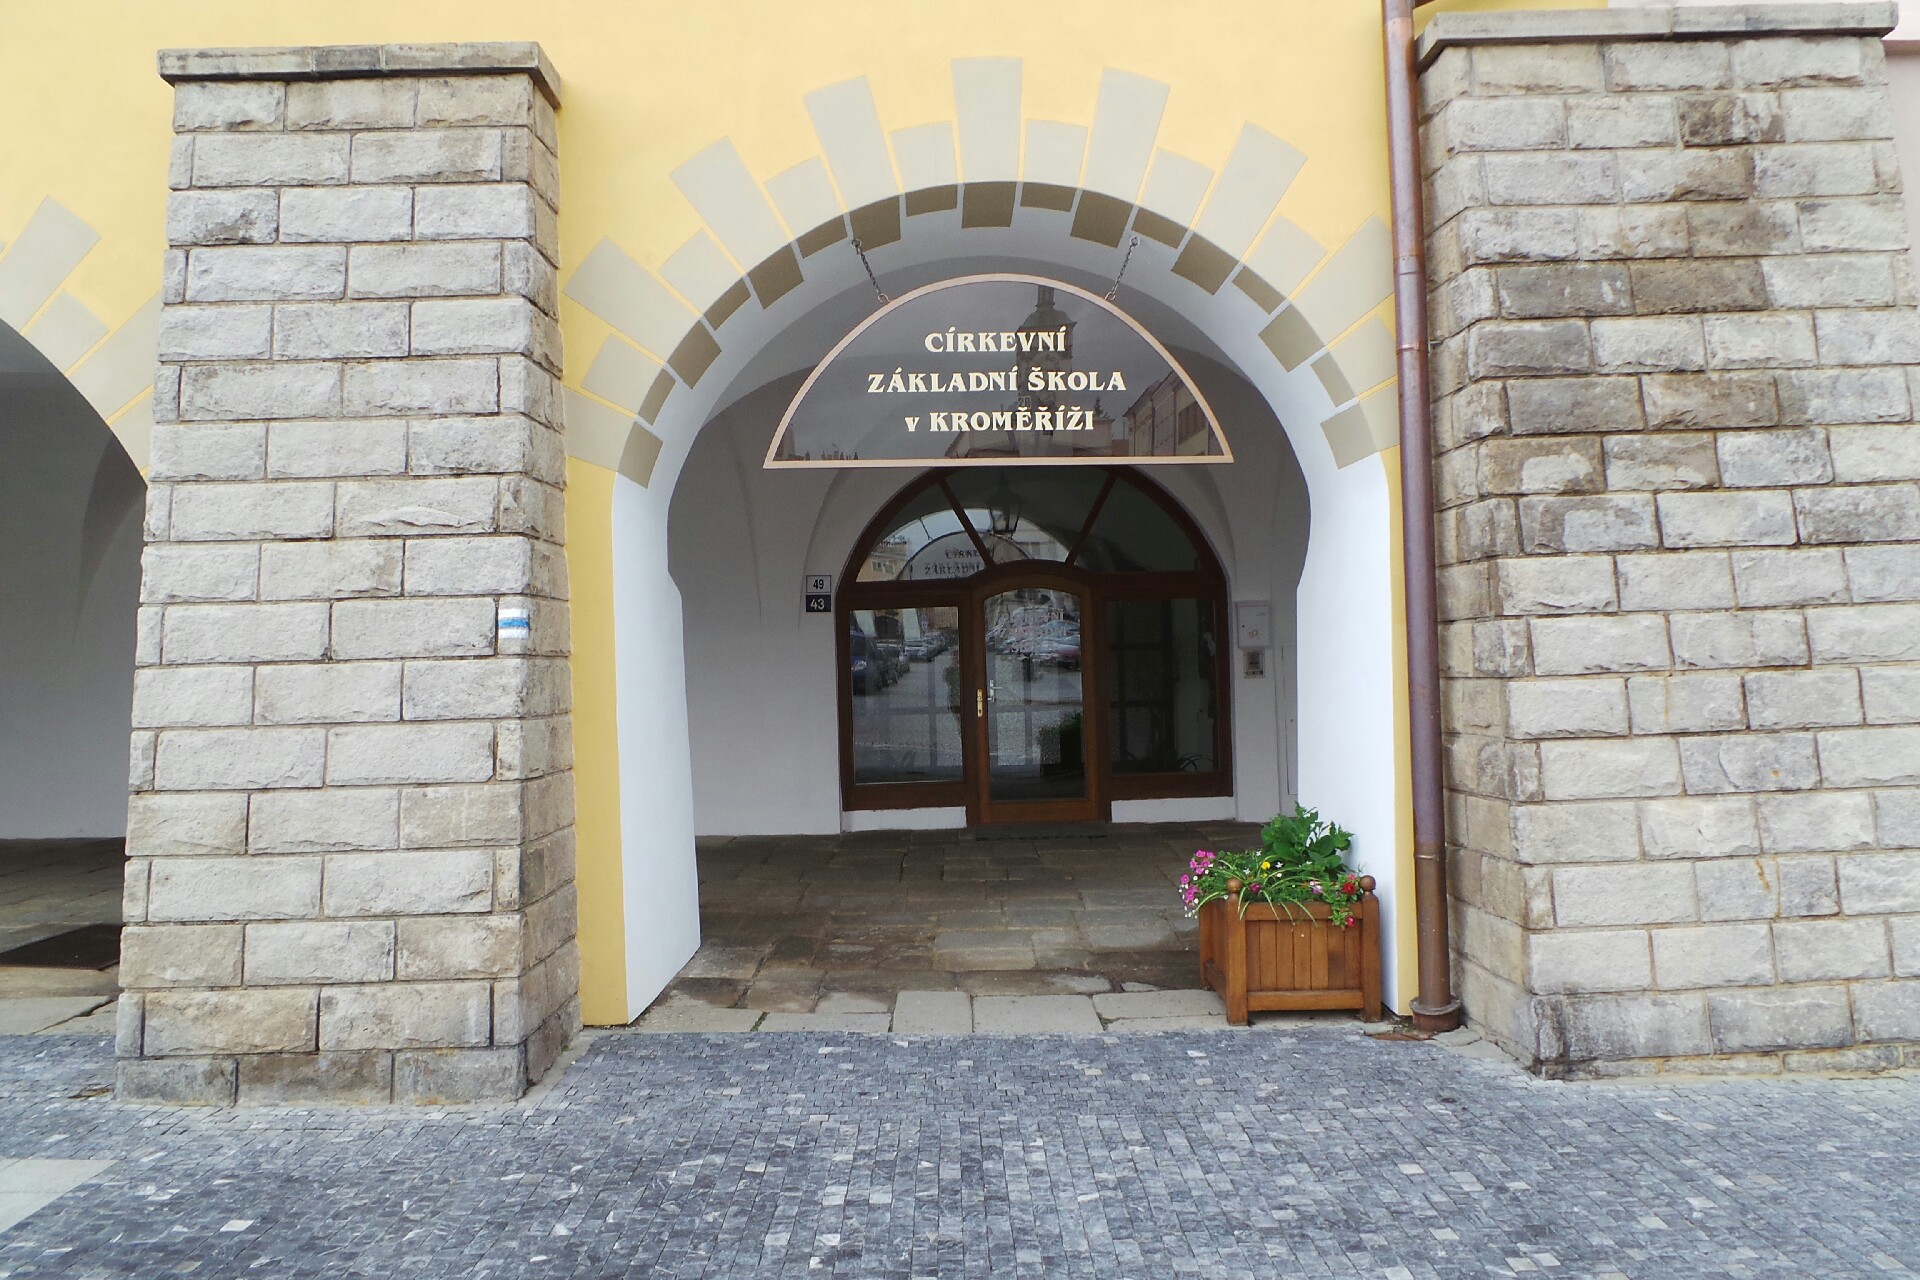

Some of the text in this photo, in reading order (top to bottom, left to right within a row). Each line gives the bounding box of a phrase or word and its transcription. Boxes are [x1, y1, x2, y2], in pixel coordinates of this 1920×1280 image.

[924, 325, 1067, 353] CÍRKEVNÍ
[867, 365, 1127, 393] ZÁKLADNÍ ŠKOLA
[904, 405, 1094, 432] v KROMĚŘÍŽI
[813, 579, 824, 590] 49
[810, 598, 825, 610] 43
